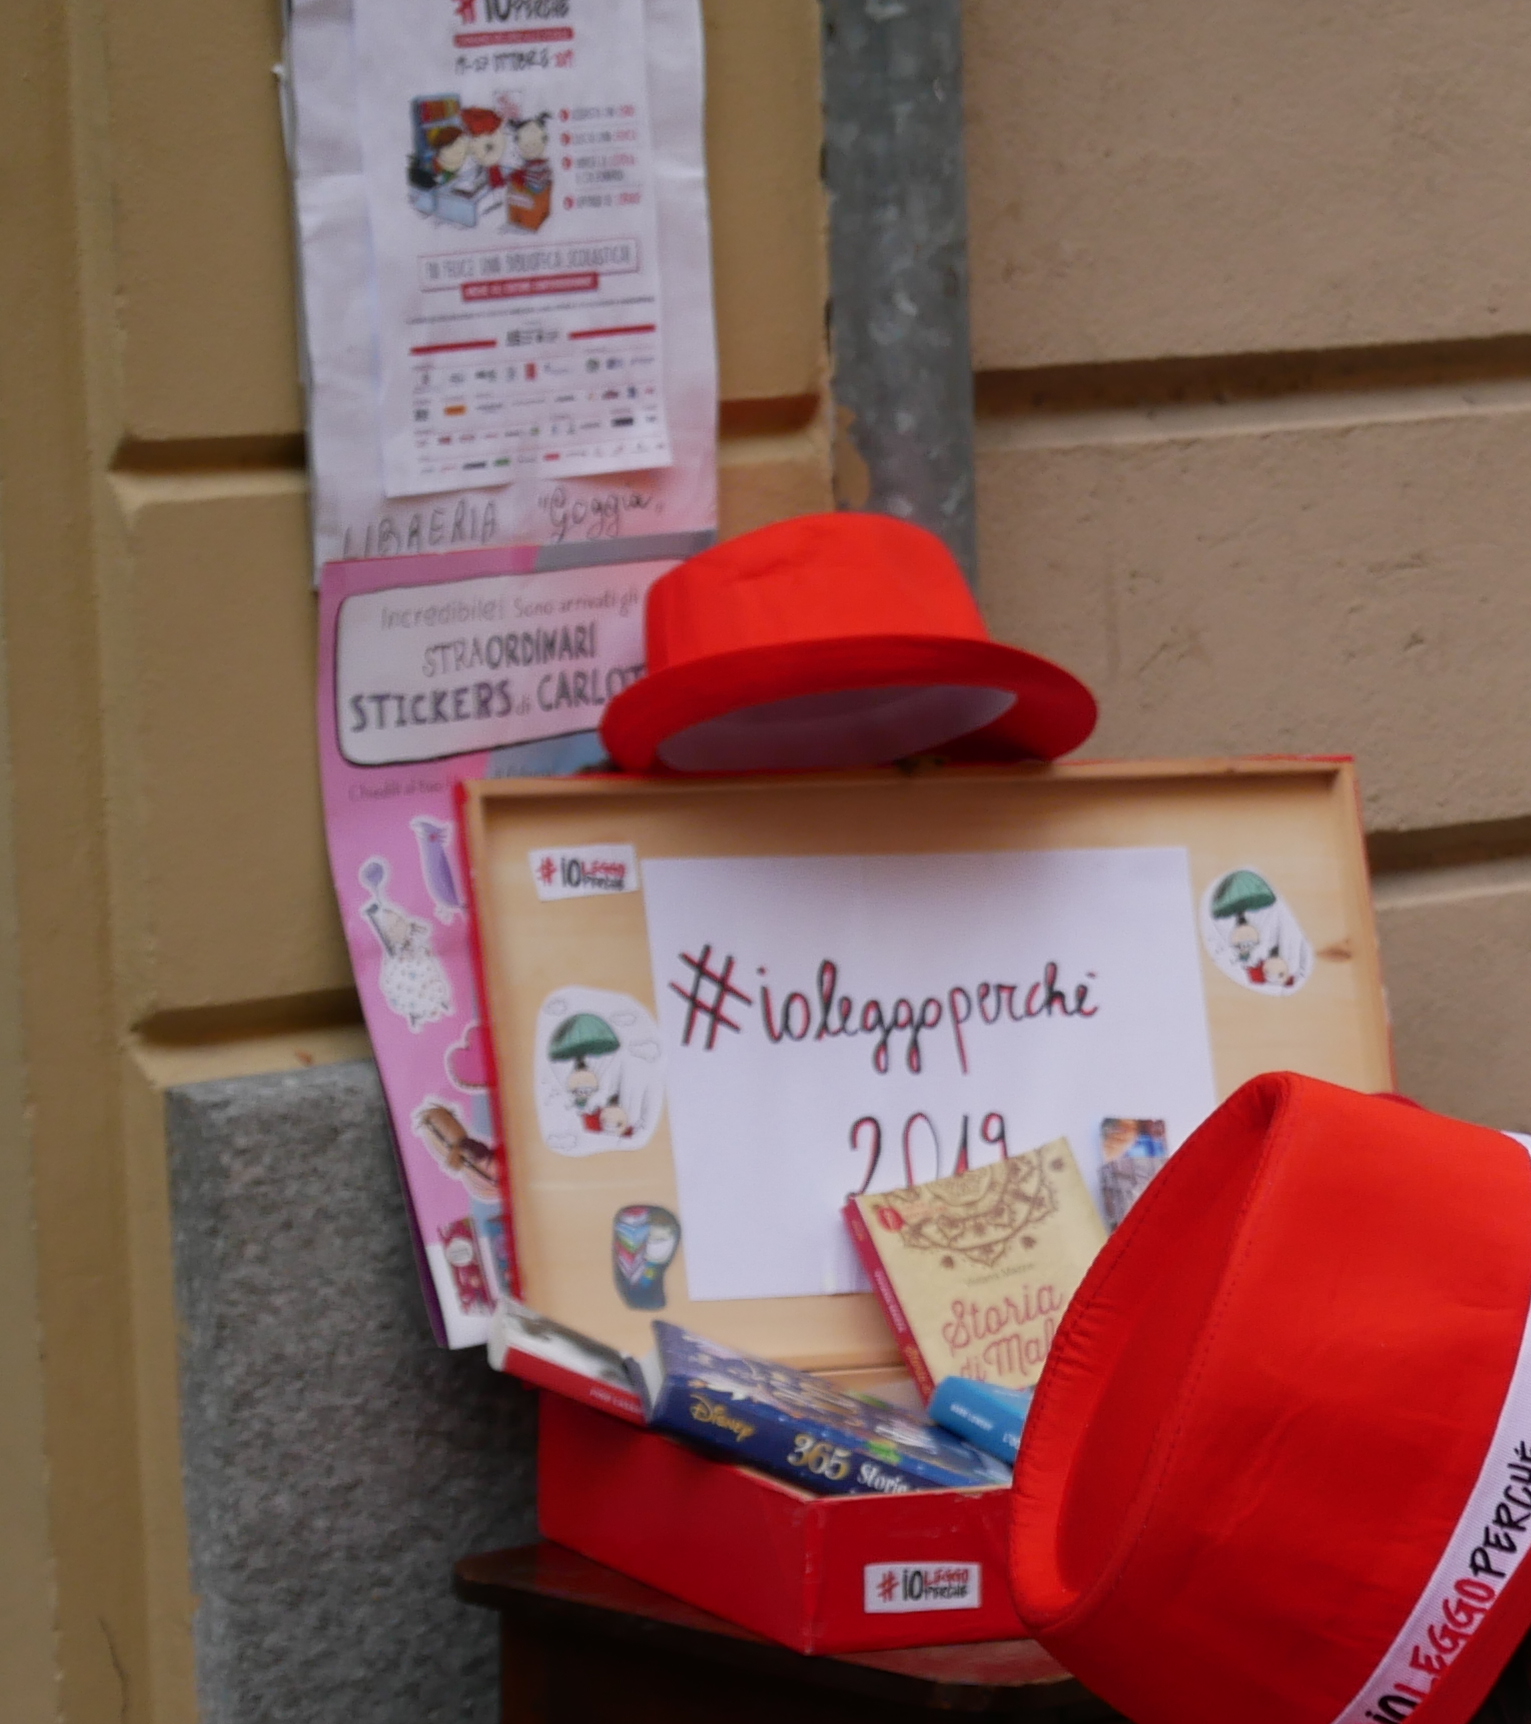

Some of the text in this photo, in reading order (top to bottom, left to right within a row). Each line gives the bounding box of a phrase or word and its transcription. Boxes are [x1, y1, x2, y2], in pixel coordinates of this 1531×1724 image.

[422, 622, 597, 678] STRAORDINARI
[350, 678, 512, 732] STICKERS
[942, 1283, 1064, 1357] Storia
[983, 1317, 1054, 1377] Mal
[786, 1433, 852, 1480] 365
